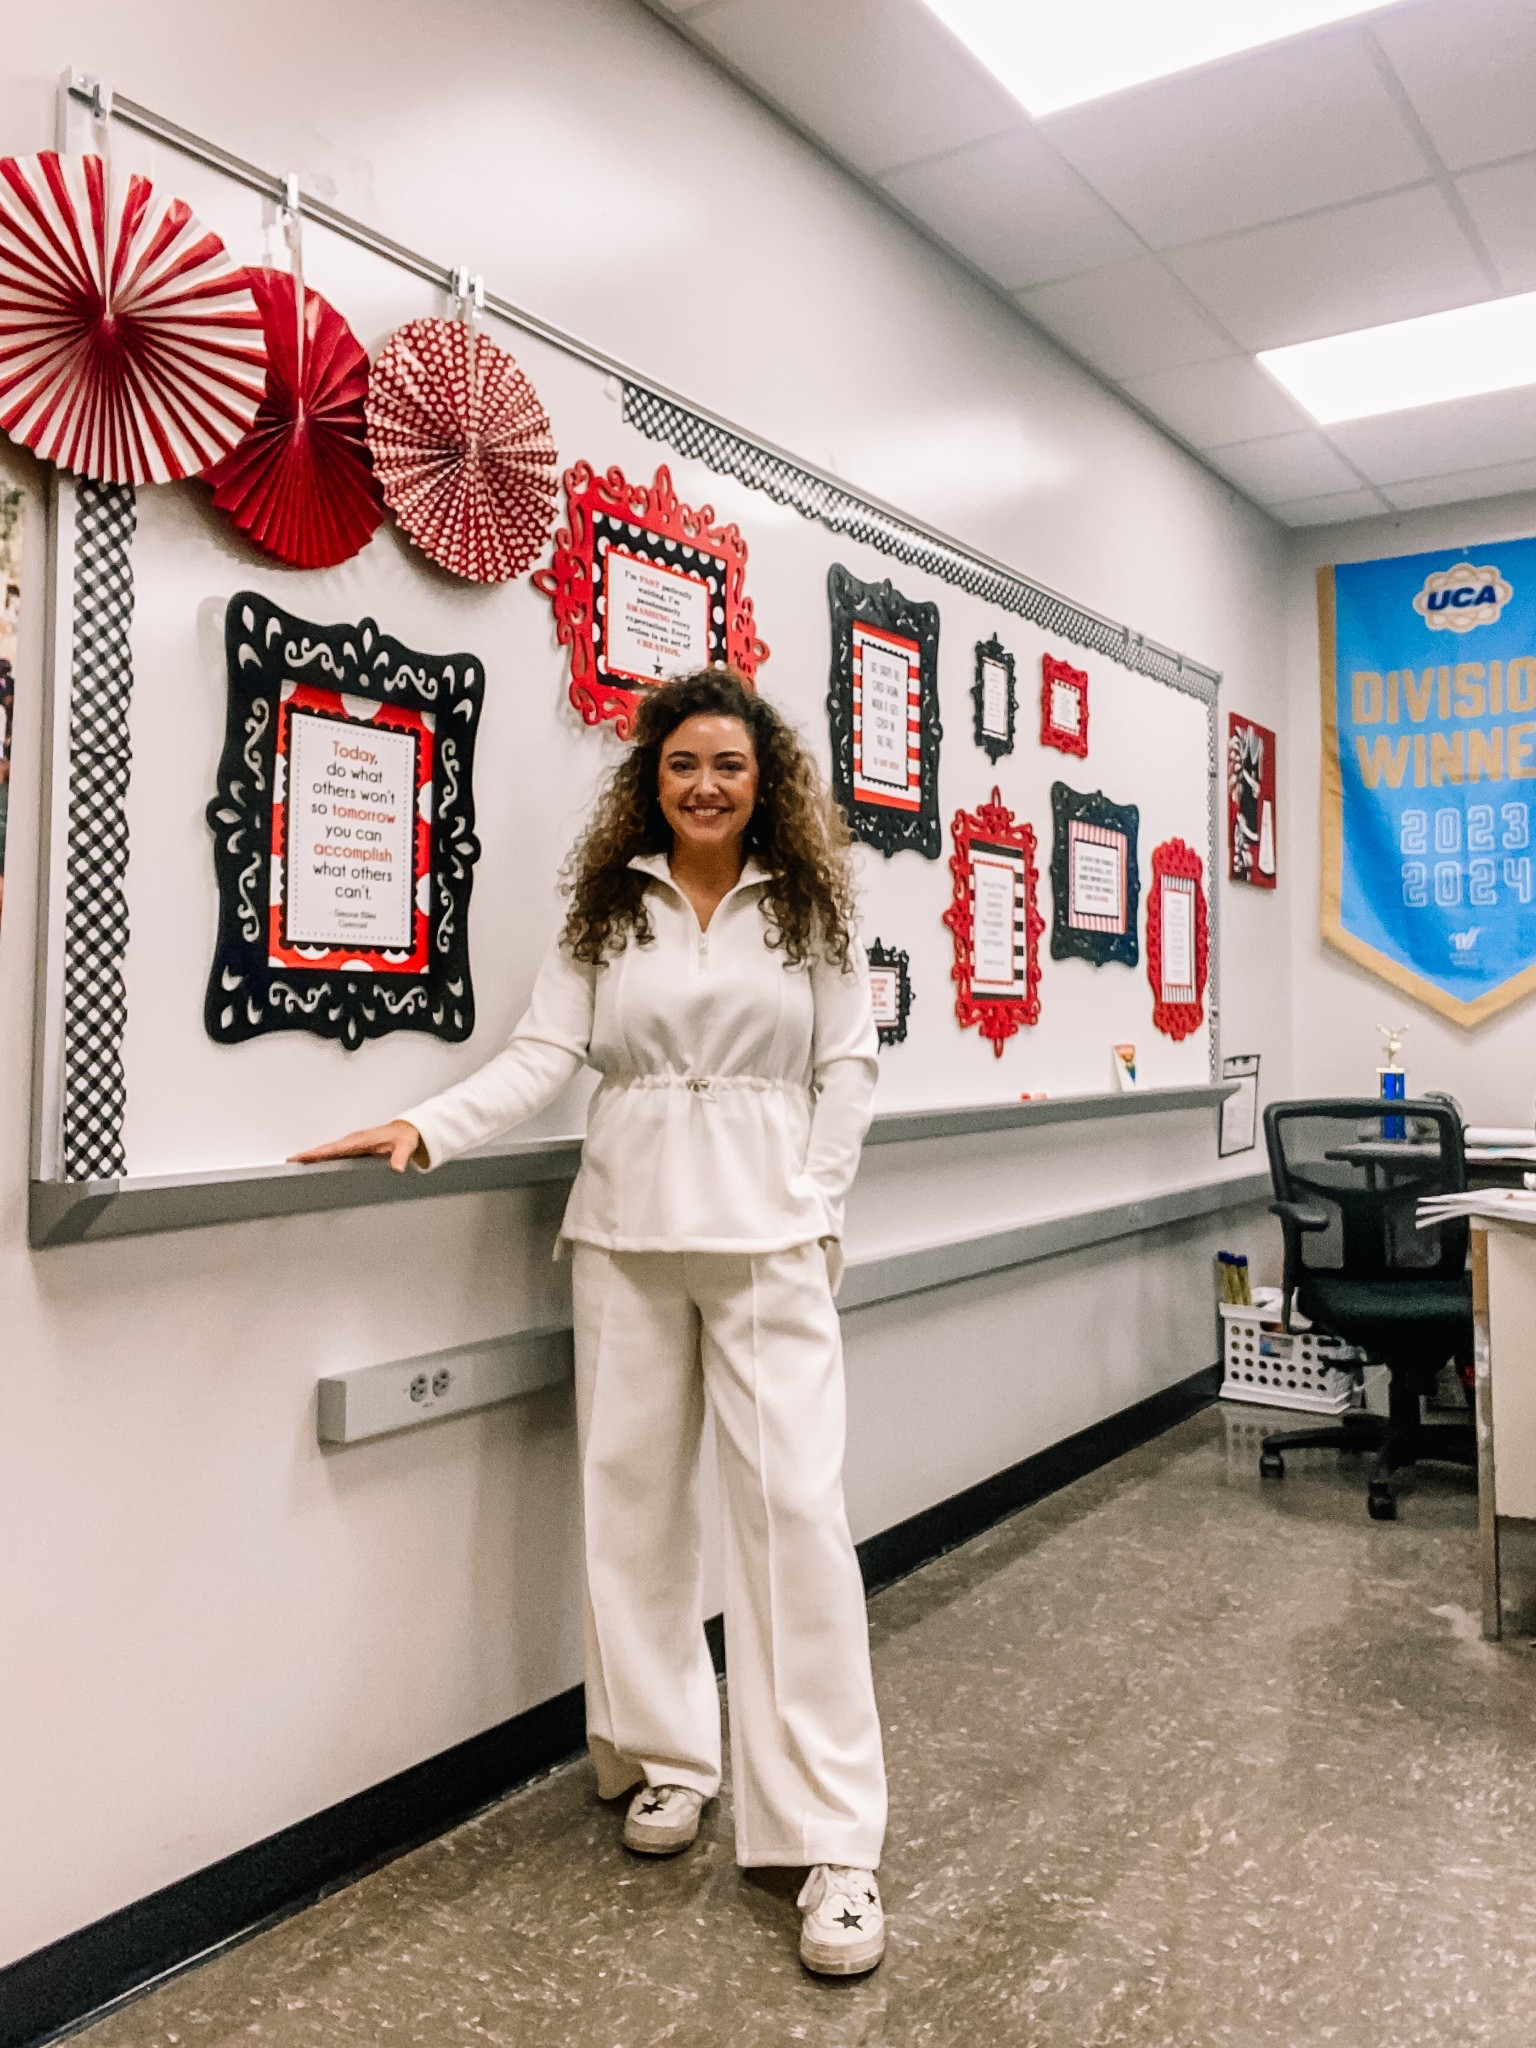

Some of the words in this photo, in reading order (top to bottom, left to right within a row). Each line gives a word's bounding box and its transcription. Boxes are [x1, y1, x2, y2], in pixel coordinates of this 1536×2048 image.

[1427, 585, 1496, 611] UCA
[333, 740, 378, 765] Today,
[327, 761, 346, 778] do
[351, 766, 383, 783] what
[313, 781, 356, 799] others
[361, 789, 395, 805] won't
[312, 803, 328, 815] so
[332, 803, 396, 824] tomorrow
[326, 825, 352, 839] you
[355, 829, 382, 842] can
[1401, 802, 1529, 855] 2023
[313, 843, 393, 863] accomplish
[313, 860, 346, 878] what
[351, 866, 393, 882] others
[335, 884, 372, 900] can't.
[1401, 857, 1532, 908] 2024
